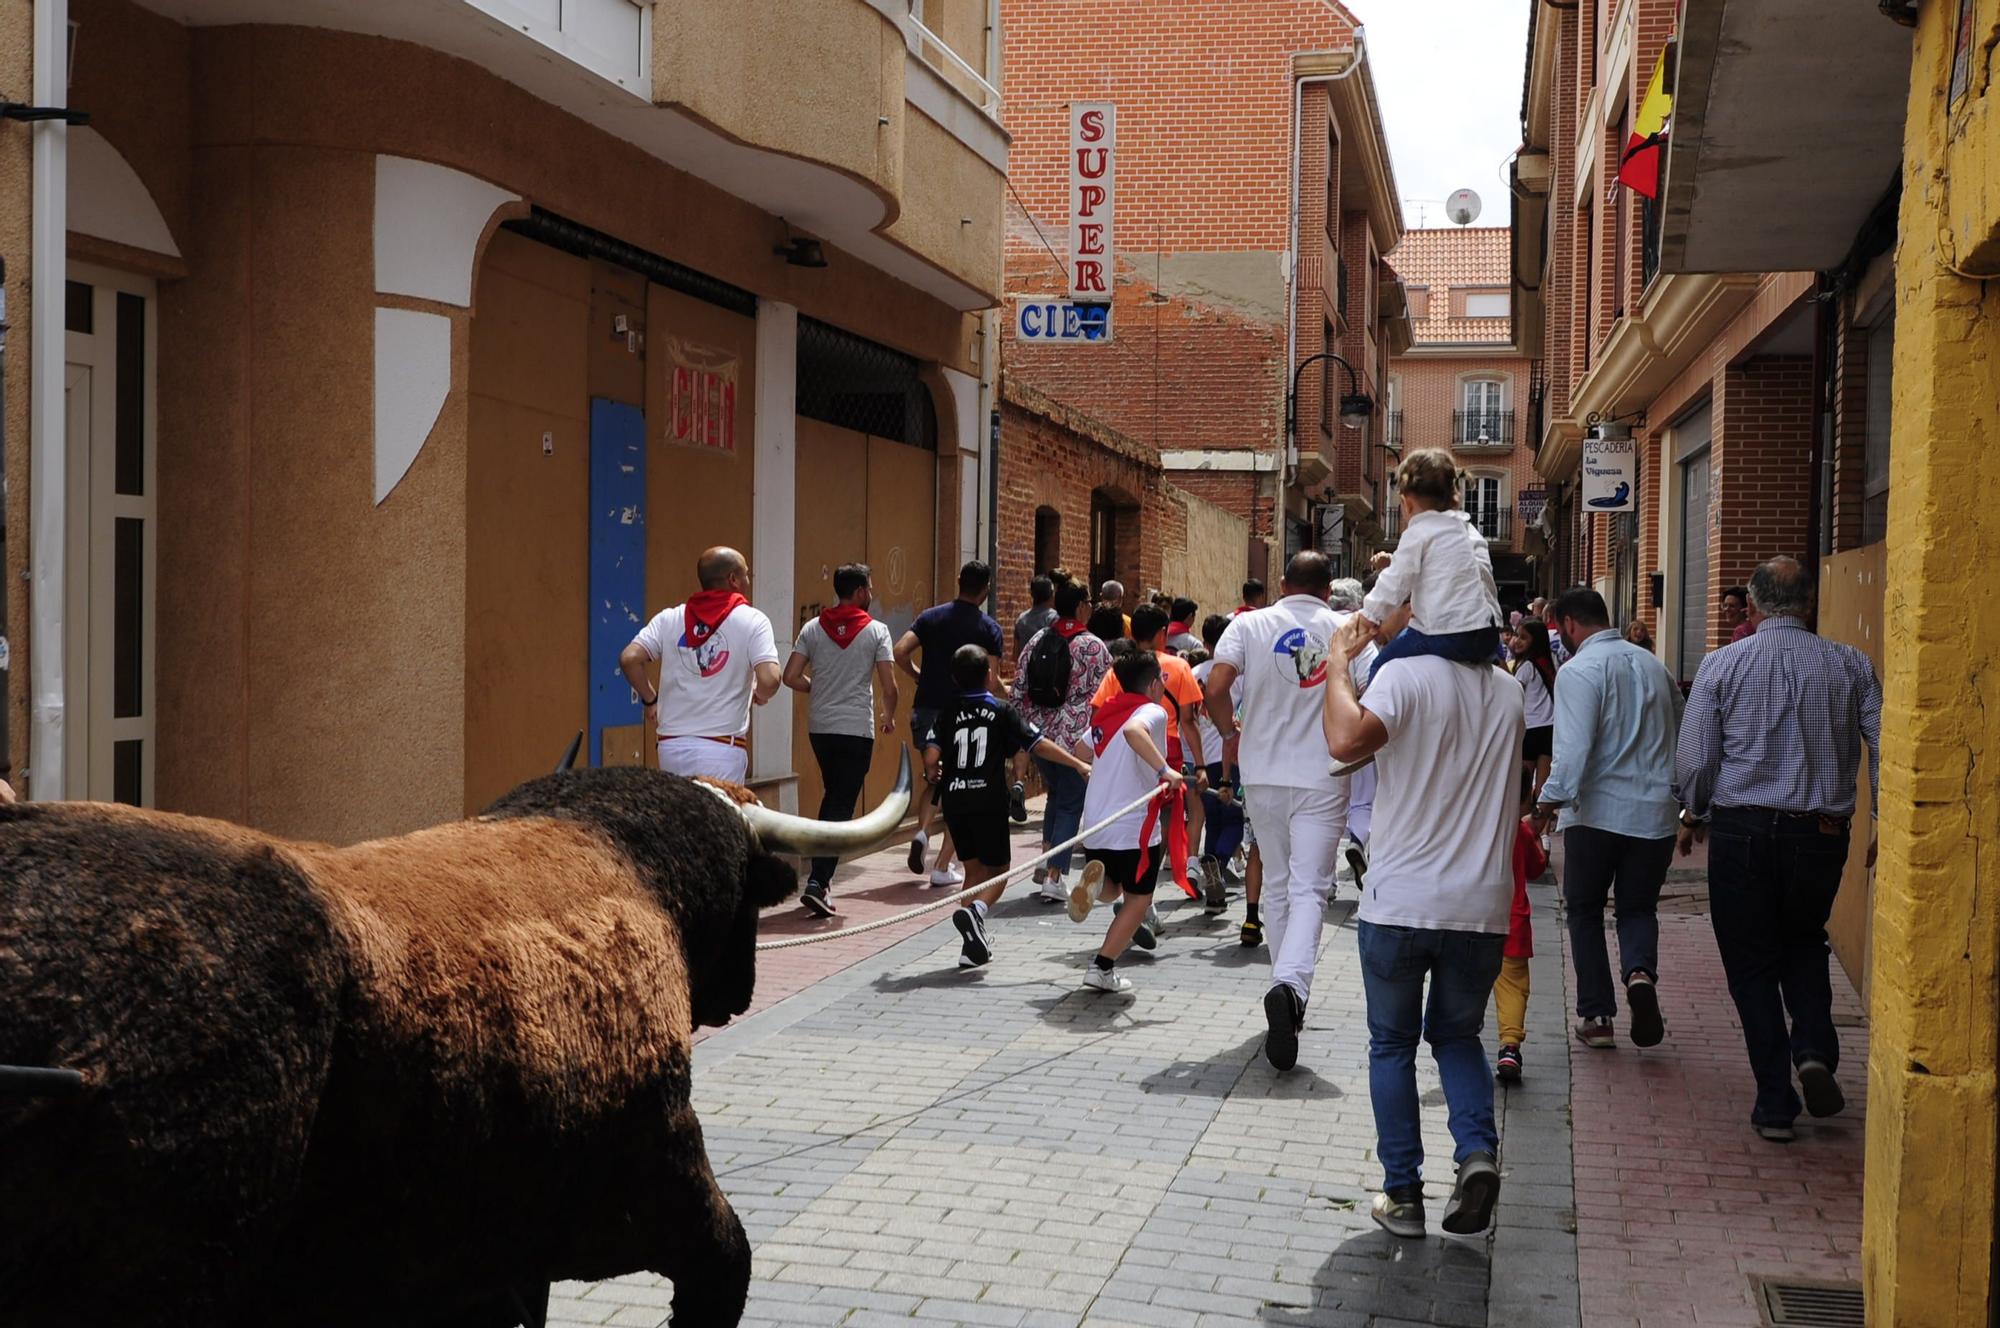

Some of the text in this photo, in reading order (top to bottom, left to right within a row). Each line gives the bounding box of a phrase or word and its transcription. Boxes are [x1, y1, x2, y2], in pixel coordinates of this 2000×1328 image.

[1075, 111, 1109, 292] SUPER
[1585, 456, 1597, 464] La
[1585, 467, 1622, 477] Viguesa
[953, 726, 988, 769] 11
